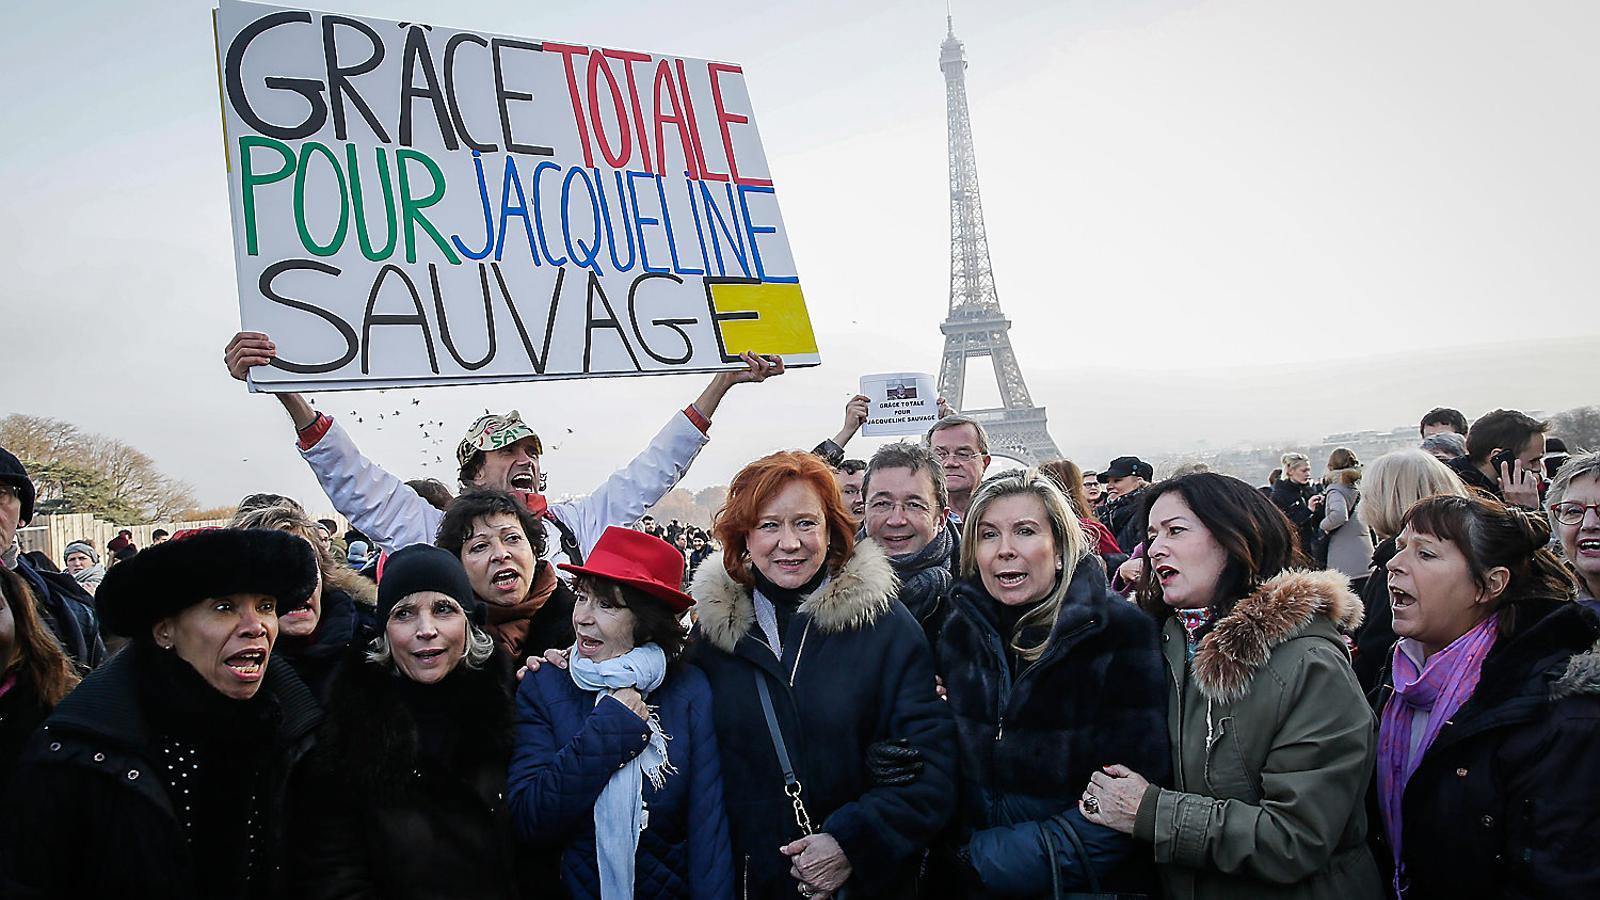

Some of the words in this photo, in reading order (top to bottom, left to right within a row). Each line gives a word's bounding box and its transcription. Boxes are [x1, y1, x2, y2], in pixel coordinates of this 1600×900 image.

[225, 11, 554, 156] GRÂCE
[542, 42, 773, 186] TOTALE
[238, 135, 462, 265] POUR
[450, 149, 799, 283] JACQUELINE
[258, 258, 771, 374] SAUVAGE
